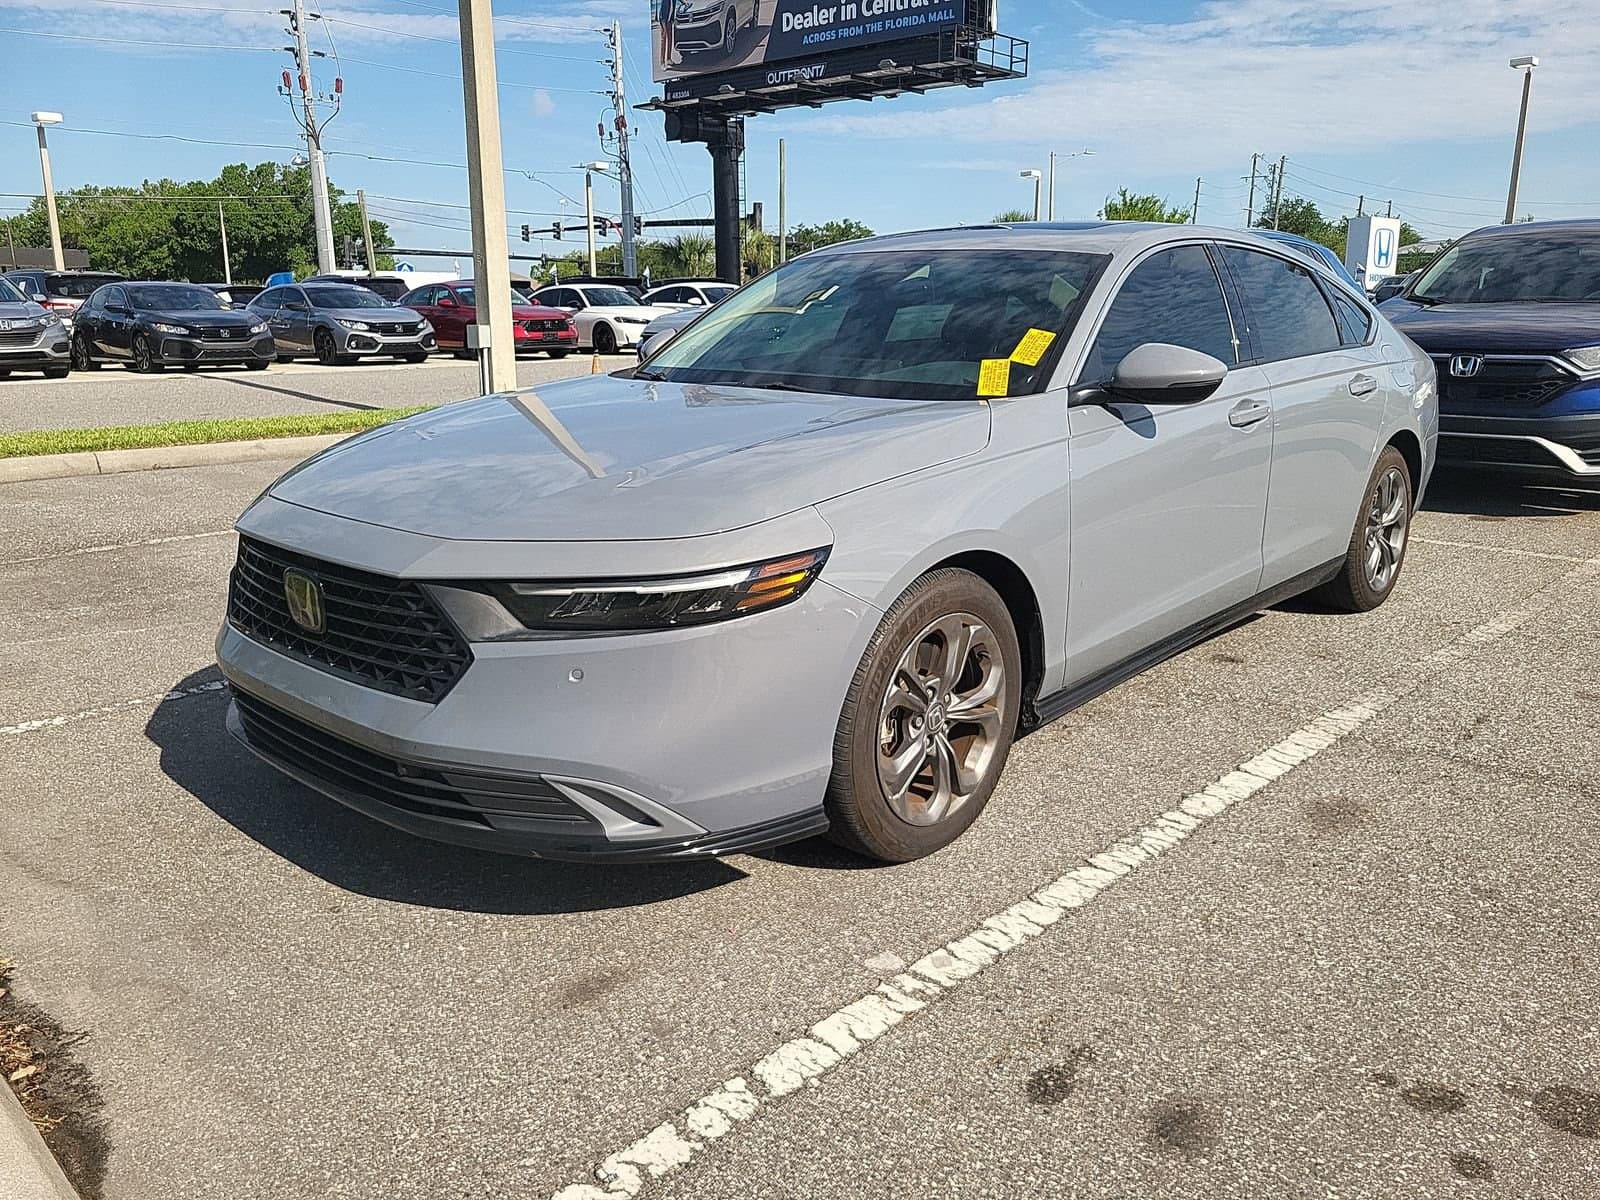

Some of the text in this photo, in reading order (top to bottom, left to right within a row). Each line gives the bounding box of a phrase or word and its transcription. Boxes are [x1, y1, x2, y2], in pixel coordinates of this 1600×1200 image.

[782, 5, 838, 33] Dealer
[840, 1, 857, 22] in
[803, 9, 955, 45] ACROSS FROM THE FLORIDA MALL
